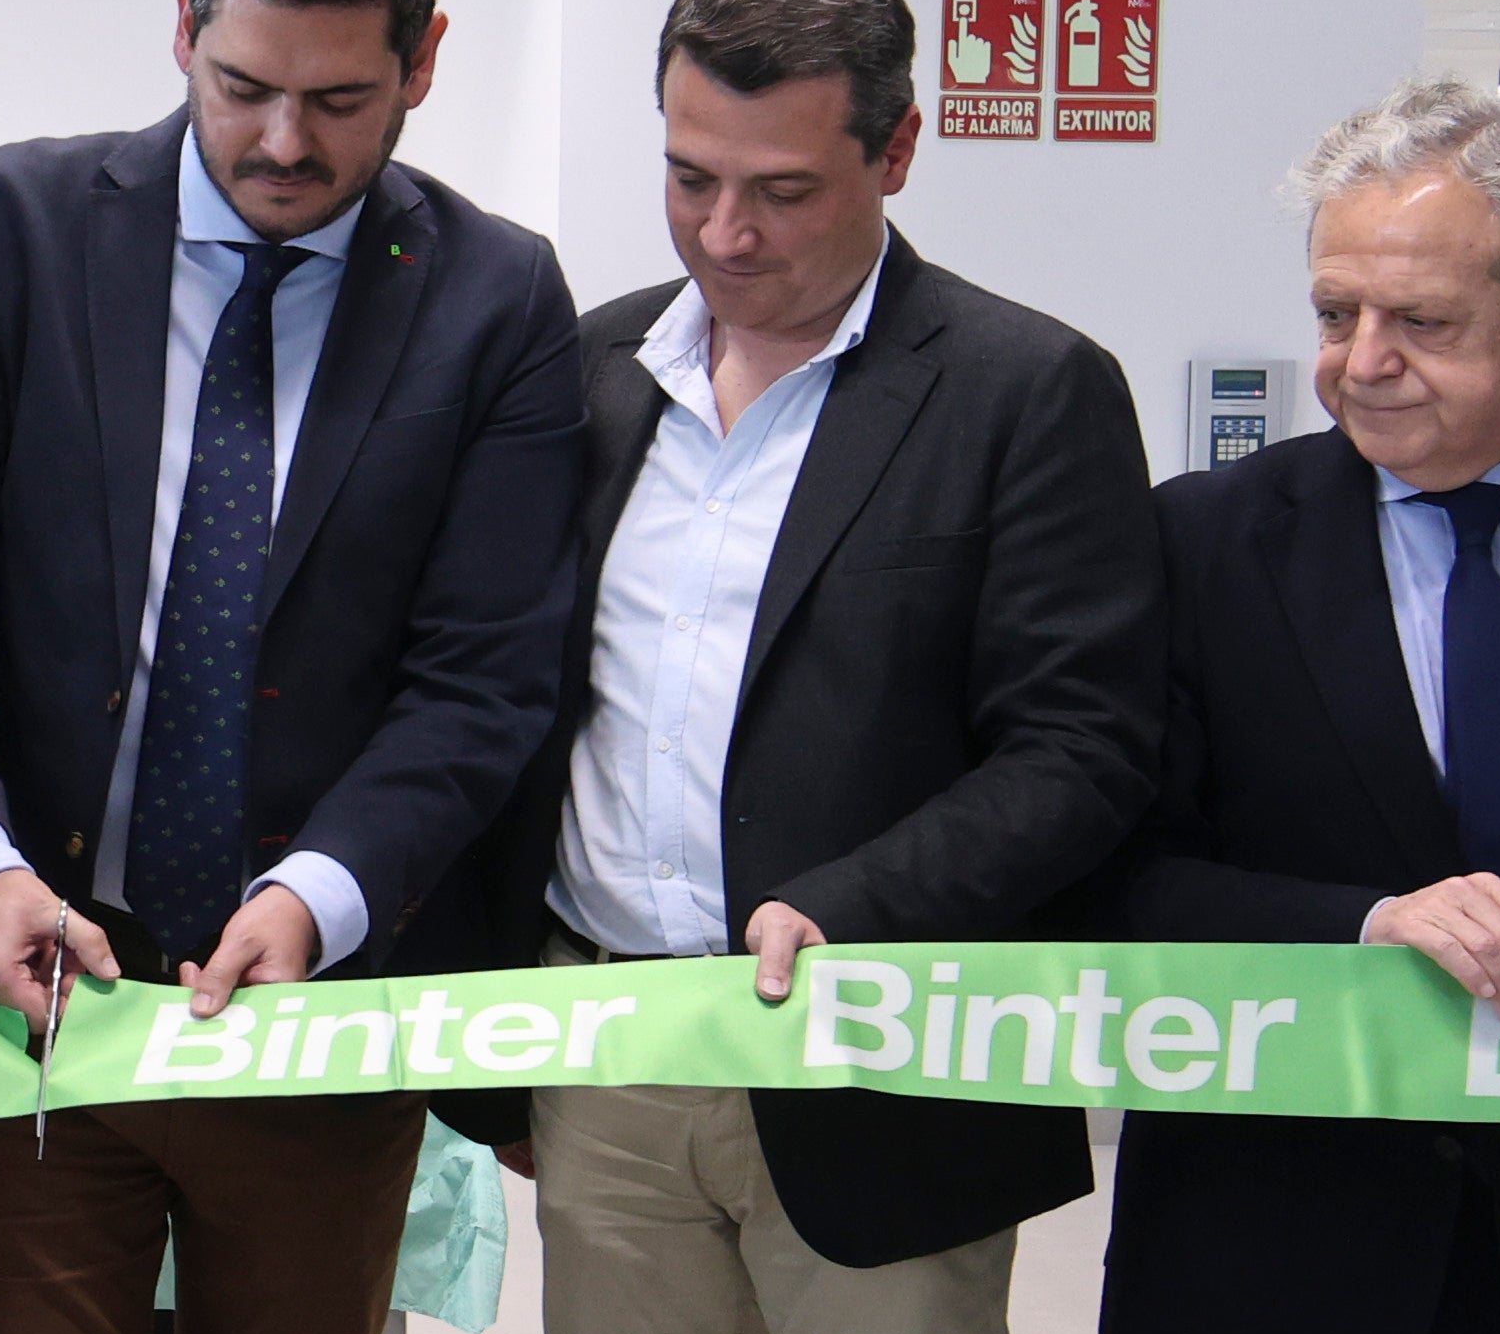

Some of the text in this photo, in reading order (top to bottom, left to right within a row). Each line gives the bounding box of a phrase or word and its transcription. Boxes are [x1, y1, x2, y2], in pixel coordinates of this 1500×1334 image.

[944, 99, 1035, 116] PULSADOR
[944, 118, 1034, 136] DE ALARMA
[1059, 110, 1151, 132] EXTINTOR
[130, 988, 640, 1087] Binter
[801, 958, 1299, 1094] Binter
